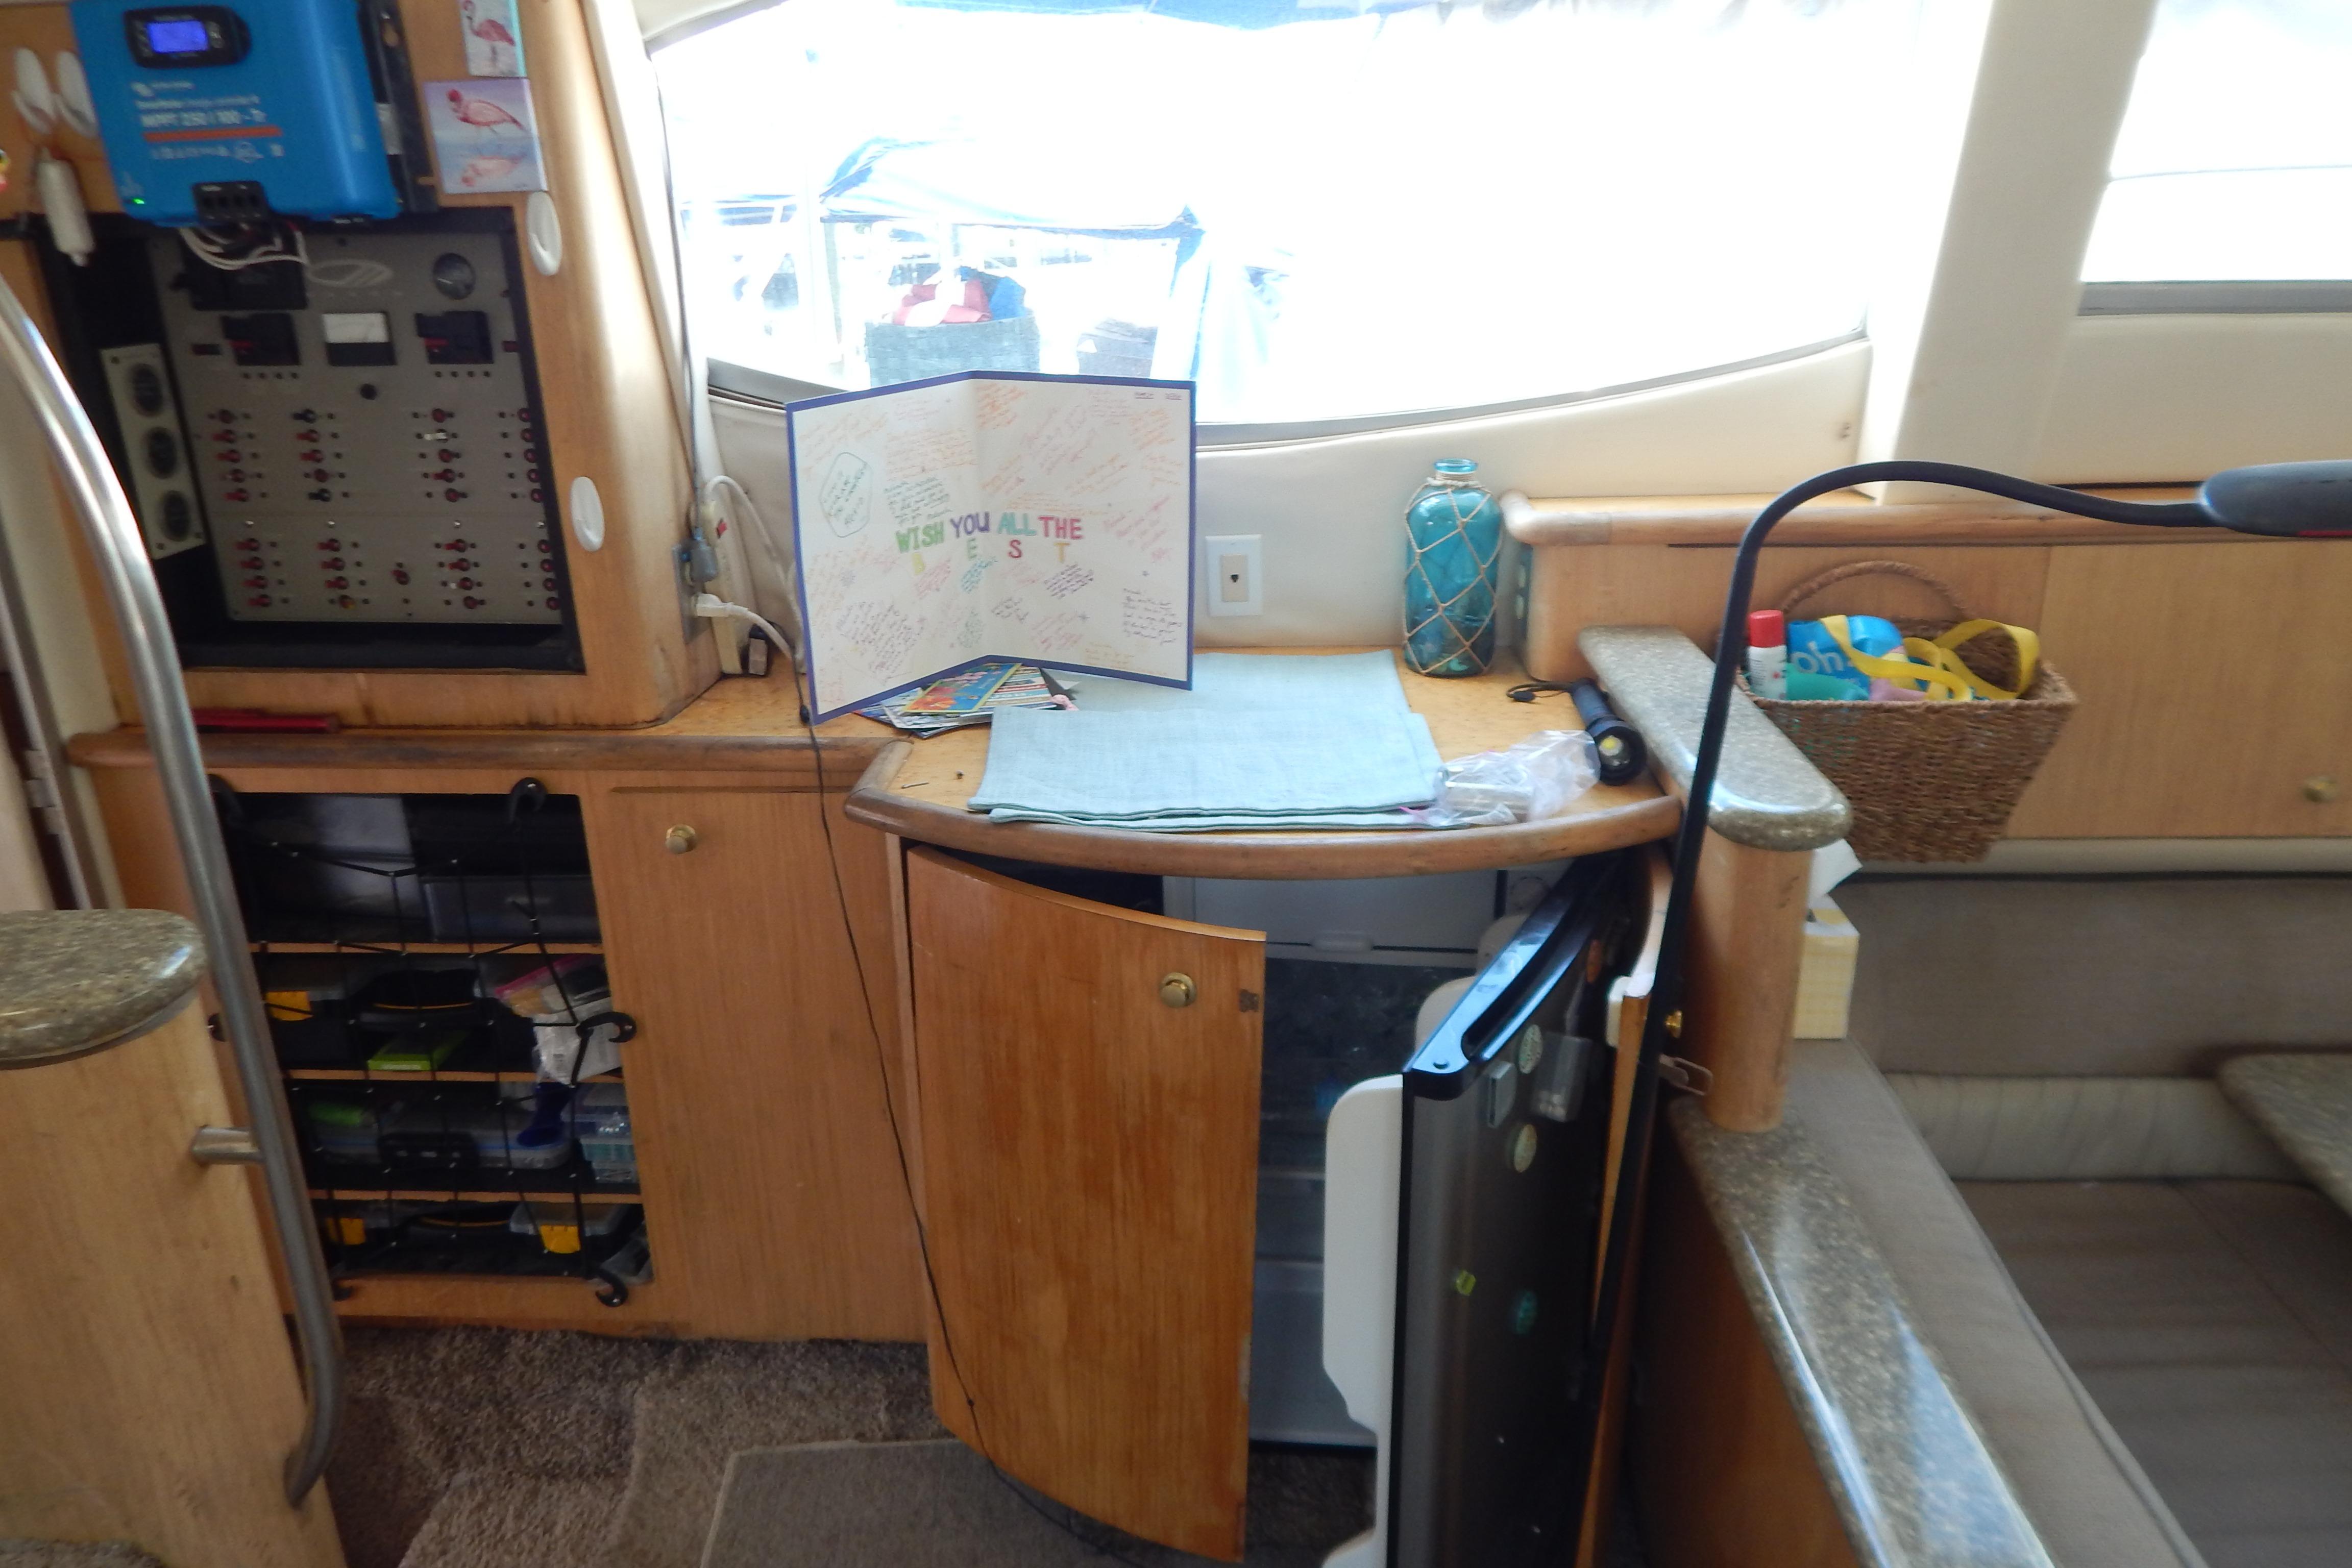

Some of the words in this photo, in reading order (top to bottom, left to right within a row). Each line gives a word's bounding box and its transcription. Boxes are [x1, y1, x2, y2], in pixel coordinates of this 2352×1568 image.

[896, 521, 944, 553] WISH
[950, 512, 990, 537] YOU
[997, 512, 1037, 536] ALL
[1038, 517, 1083, 539] THE
